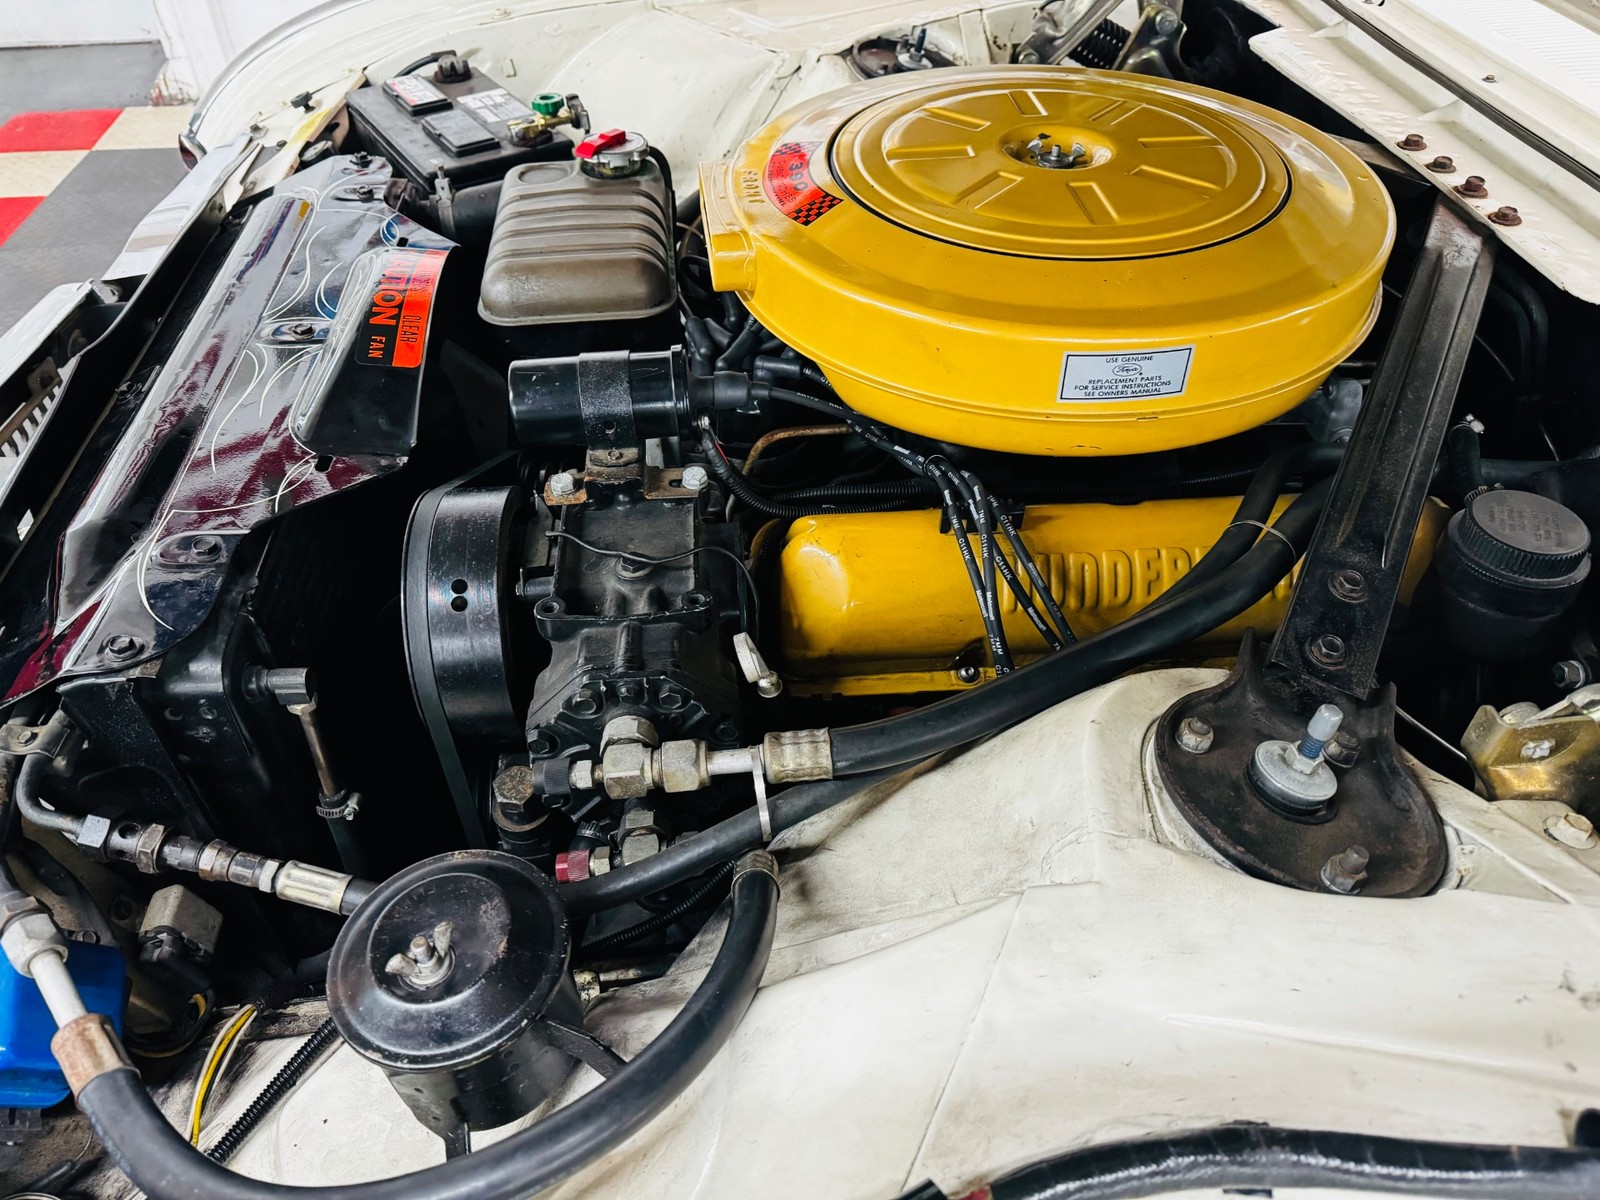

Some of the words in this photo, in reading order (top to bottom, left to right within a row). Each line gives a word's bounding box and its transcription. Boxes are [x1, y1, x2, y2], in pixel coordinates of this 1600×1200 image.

[789, 161, 809, 191] 390
[400, 315, 422, 344] CLEAR
[367, 335, 386, 358] FAN
[1121, 355, 1153, 363] GENUINE
[1088, 376, 1139, 385] REPLACEMENT
[1140, 375, 1162, 383] PARTS
[1091, 383, 1119, 391] SERVICE
[1121, 380, 1172, 390] INSTRUCTIONS
[1098, 389, 1128, 397] OWNERS
[1130, 387, 1161, 396] MANUAL
[1000, 515, 1017, 537] C11HK
[958, 538, 971, 562] C11HK
[995, 556, 1013, 581] C11HK
[981, 533, 989, 559] C11HK
[995, 636, 1004, 655] 7MM
